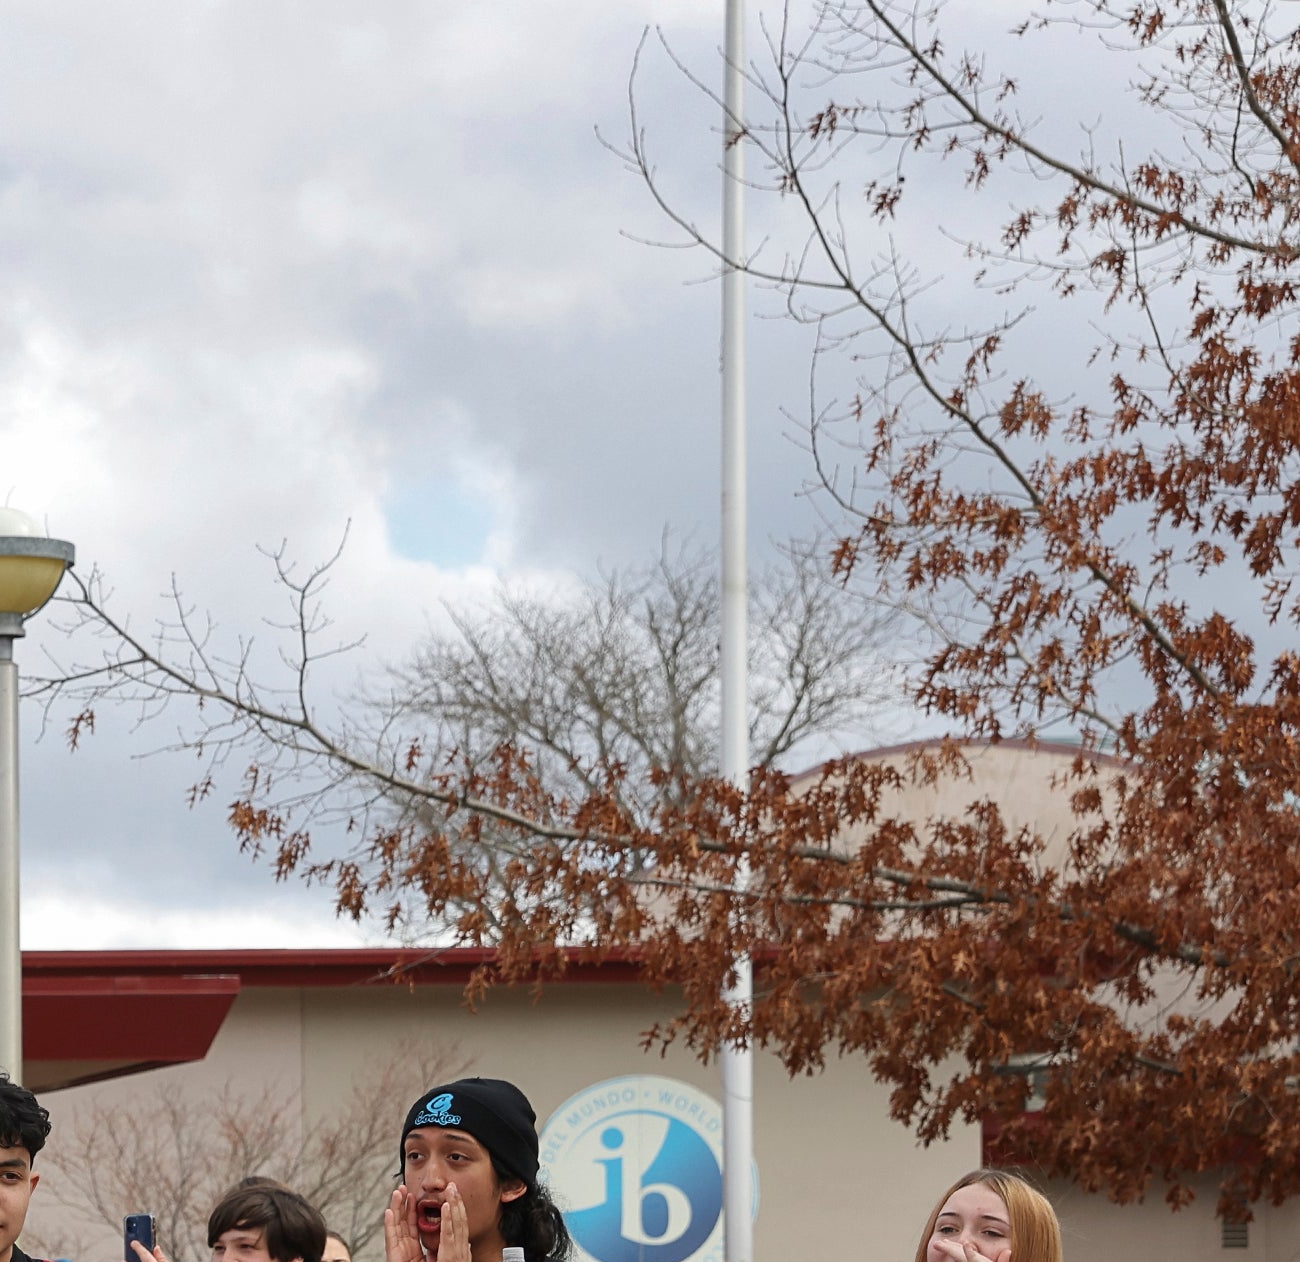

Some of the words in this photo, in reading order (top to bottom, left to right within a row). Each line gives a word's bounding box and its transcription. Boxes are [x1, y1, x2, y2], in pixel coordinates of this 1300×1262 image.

[415, 1110, 461, 1125] Cookies
[566, 1087, 636, 1128] MUNDO
[658, 1089, 721, 1133] WORLD
[593, 1126, 692, 1246] ib
